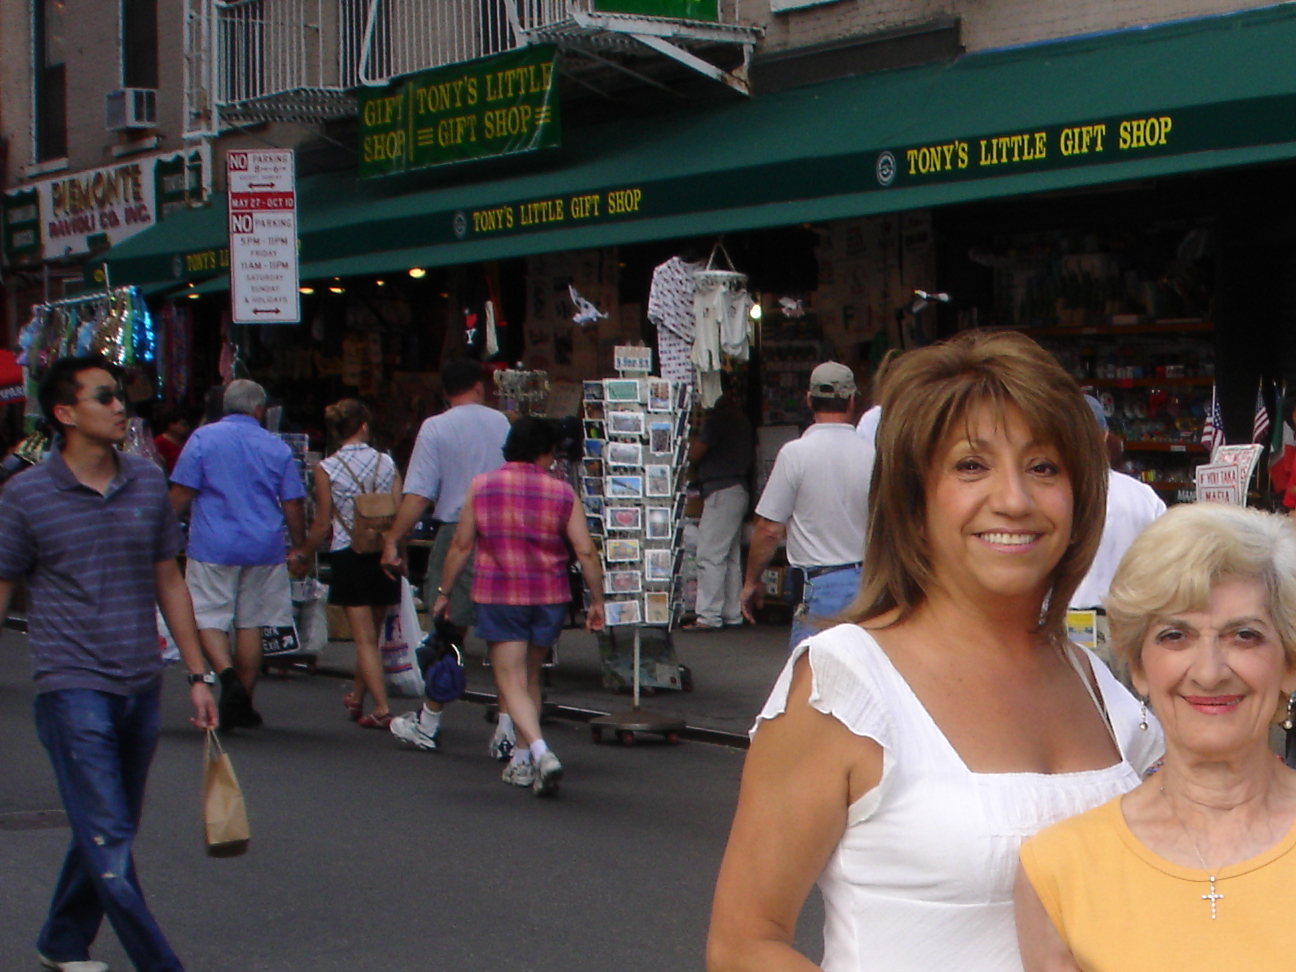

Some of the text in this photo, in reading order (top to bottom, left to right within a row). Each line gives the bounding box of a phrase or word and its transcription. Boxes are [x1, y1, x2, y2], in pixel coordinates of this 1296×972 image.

[417, 62, 554, 115] TONY'S LITTLE
[364, 95, 403, 127] GIFT
[437, 105, 532, 147] GIFT SHOP
[230, 154, 248, 169] NO
[363, 129, 405, 162] SHOP
[907, 140, 969, 175] TONY'S
[979, 132, 1046, 166] LITTLE
[1060, 124, 1106, 156] GIFT
[1118, 117, 1172, 150] SHOP
[51, 164, 144, 218] PIEMONTE
[232, 198, 248, 208] MAY
[250, 198, 260, 208] 27
[232, 213, 292, 233] NO PARKING
[472, 189, 641, 232] TONY'S LITTLE GIFT SHOP
[1207, 472, 1219, 484] YOU
